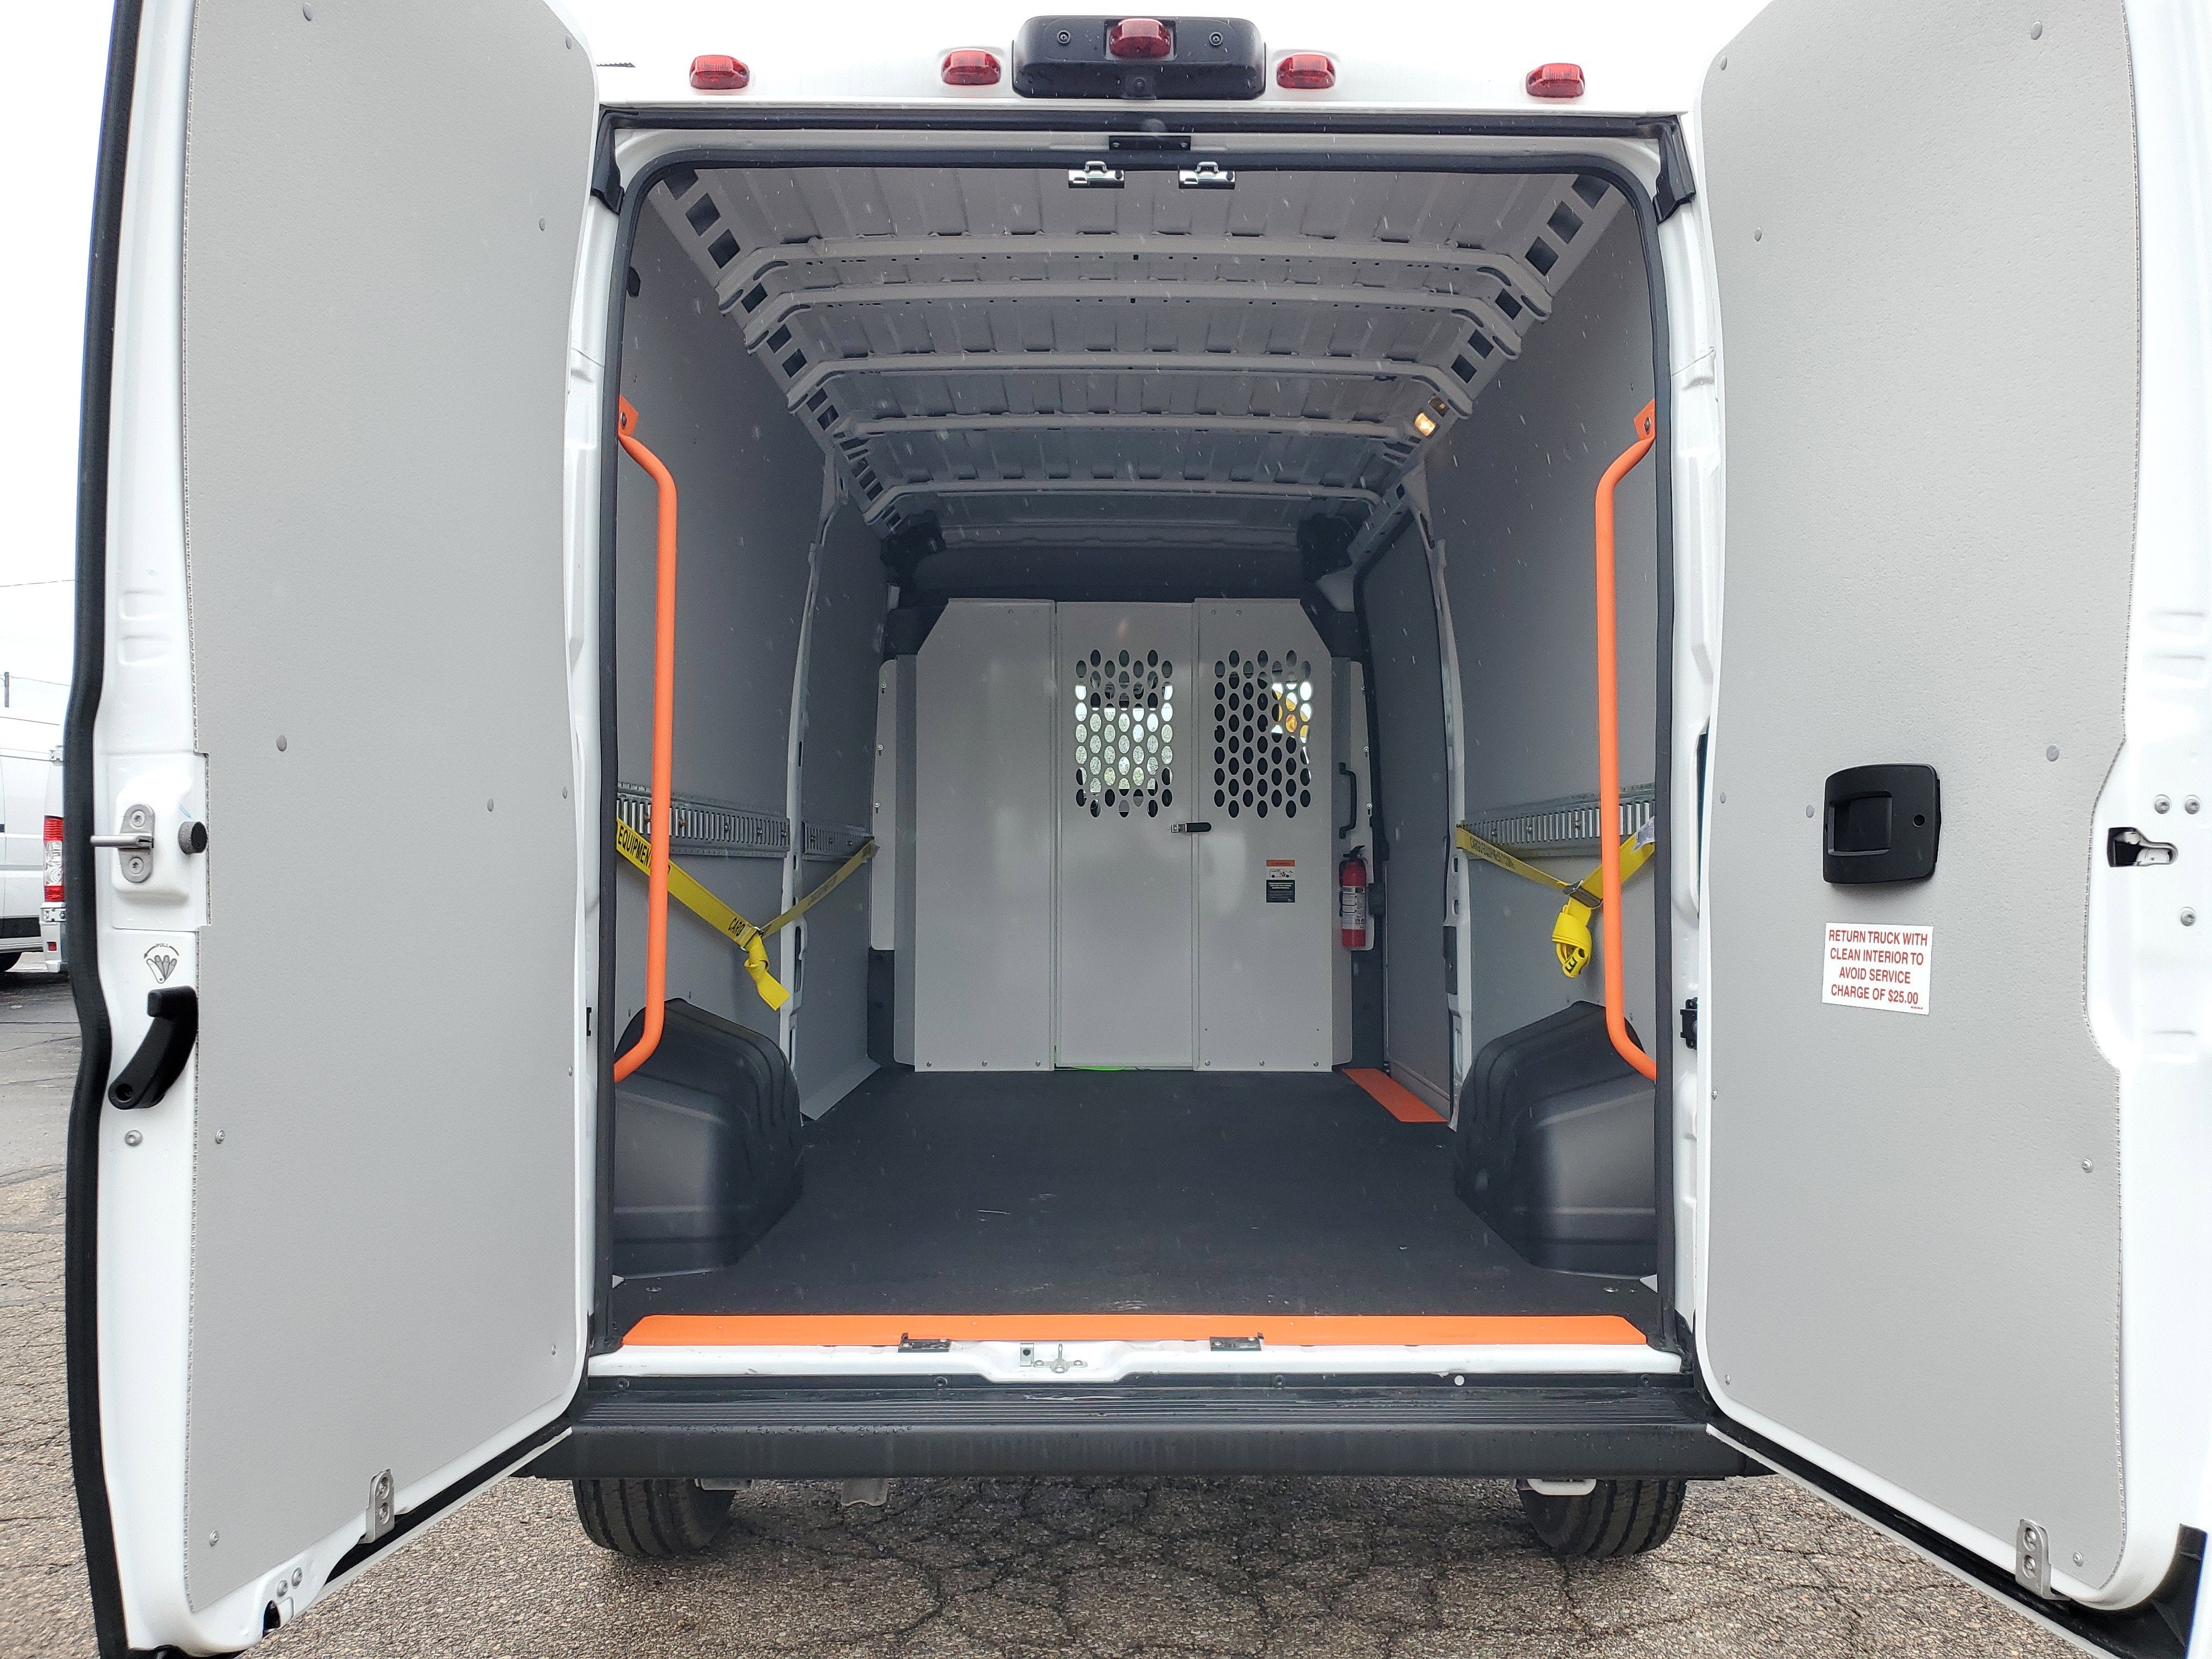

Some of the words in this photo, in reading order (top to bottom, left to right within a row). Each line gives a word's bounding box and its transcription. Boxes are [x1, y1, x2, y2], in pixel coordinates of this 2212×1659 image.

[618, 825, 651, 869] EQUIPMEN
[1829, 929, 1865, 943] RETURN
[1867, 931, 1900, 945] TRUCK
[1903, 932, 1927, 946] WITH
[1830, 947, 1860, 961] CLEAN
[1863, 949, 1908, 964] INTERIOR
[1910, 952, 1923, 966] TO
[1839, 967, 1866, 980] AVOID
[1869, 968, 1911, 984] SERVICE
[1831, 984, 1870, 999] CHARGE
[1872, 988, 1886, 1001] OF
[1888, 989, 1918, 1005] $25.00
